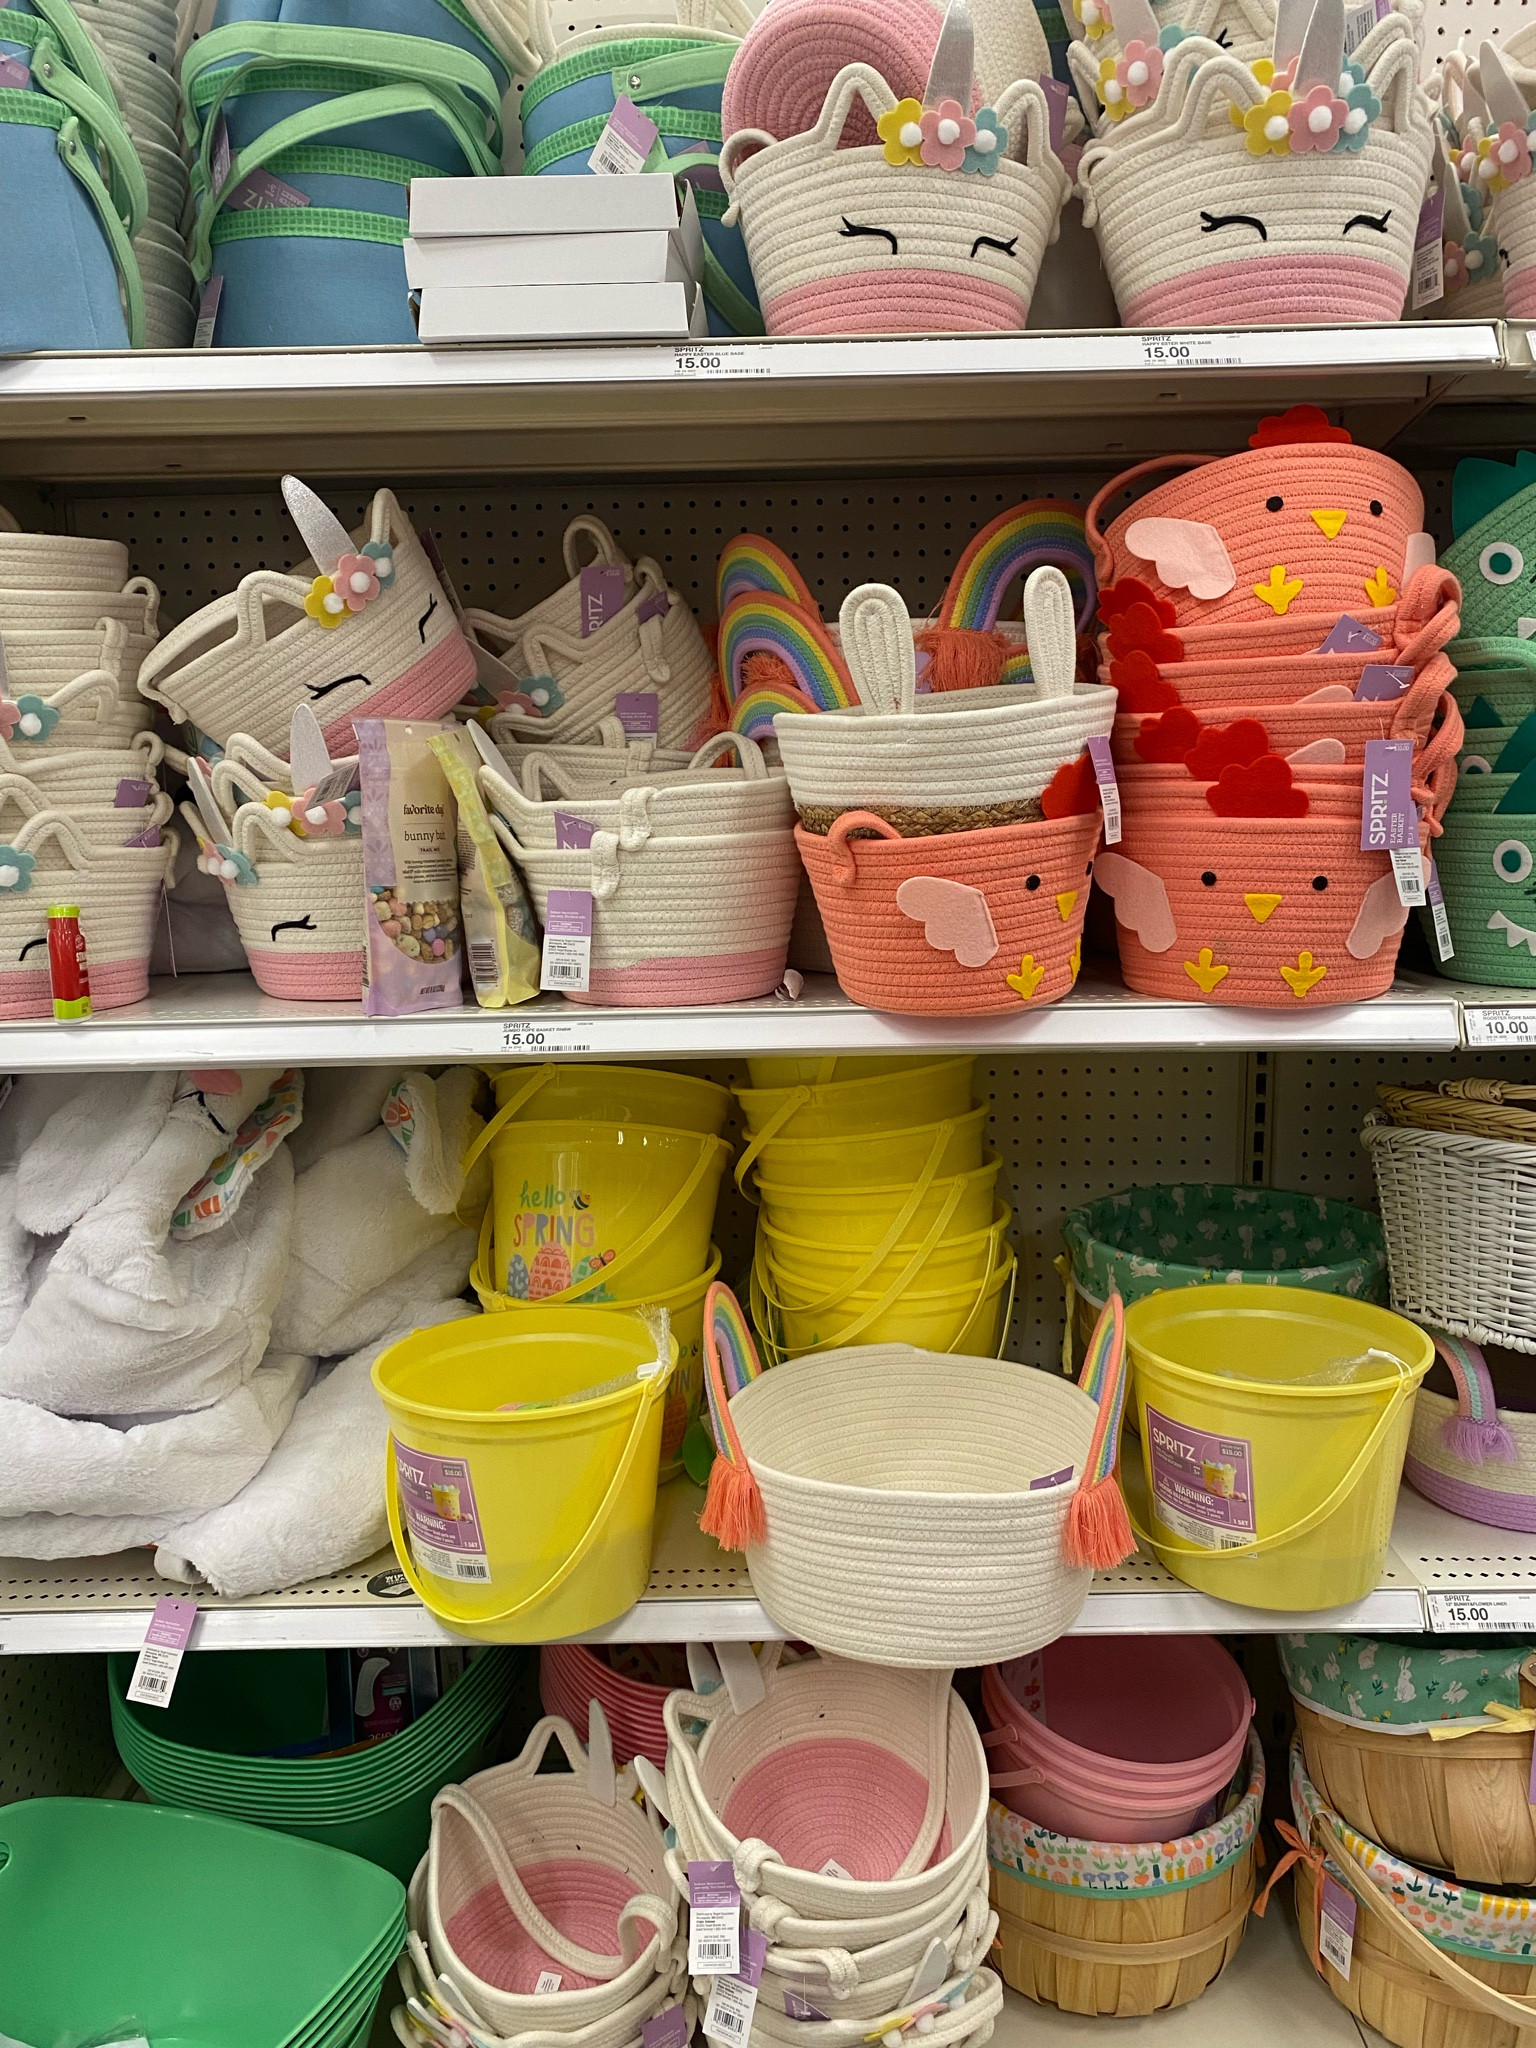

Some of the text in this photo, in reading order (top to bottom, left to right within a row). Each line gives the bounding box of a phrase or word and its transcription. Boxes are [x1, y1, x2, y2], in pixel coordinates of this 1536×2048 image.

[676, 357, 720, 368] 15.00
[1144, 346, 1190, 358] 15.00
[588, 594, 603, 631] RITZ
[403, 804, 435, 815] favorite
[1369, 773, 1389, 845] SPRITZ
[405, 831, 435, 843] bunny
[1390, 813, 1398, 845] EASTER
[1397, 812, 1405, 843] BASKET
[1486, 1021, 1528, 1034] 10.00
[503, 1033, 545, 1045] 15.00
[520, 1180, 566, 1208] hello
[513, 1213, 595, 1248] SPRING
[1152, 1427, 1243, 1462] SPRITZ $15.00
[1174, 1482, 1214, 1506] WARNING:
[416, 1512, 447, 1530] WARNING:
[1448, 1608, 1488, 1621] 15.00
